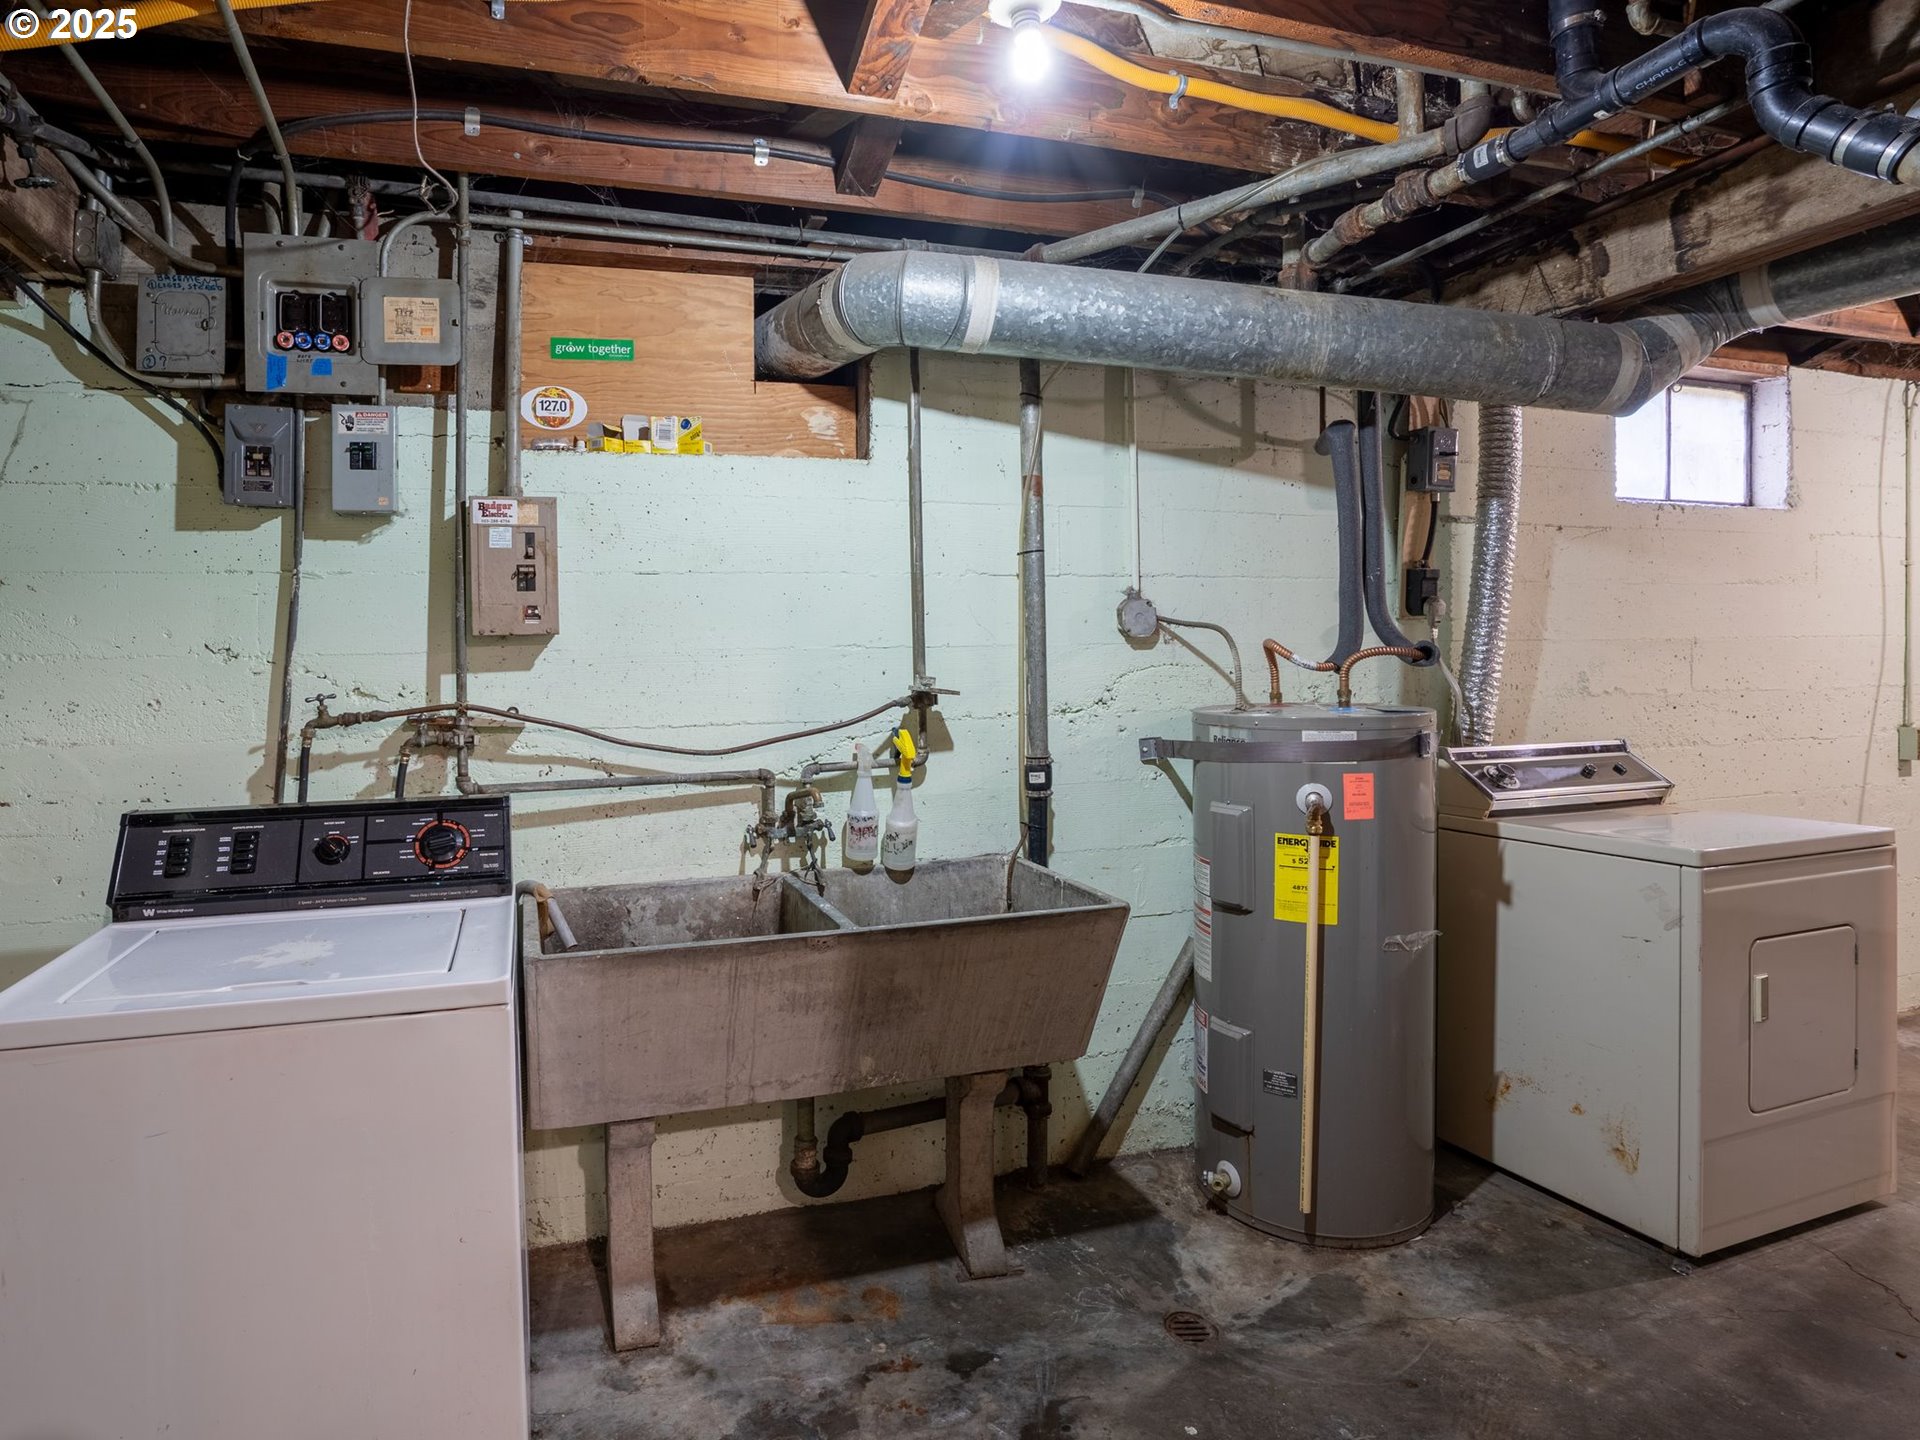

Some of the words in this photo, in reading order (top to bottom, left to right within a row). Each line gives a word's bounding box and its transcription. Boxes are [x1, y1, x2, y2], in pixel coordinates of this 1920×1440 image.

[1635, 59, 1687, 90] CHARLO
[157, 275, 220, 286] BASEMENT
[555, 341, 585, 354] grow
[587, 343, 632, 356] together
[538, 399, 567, 412] 127.0
